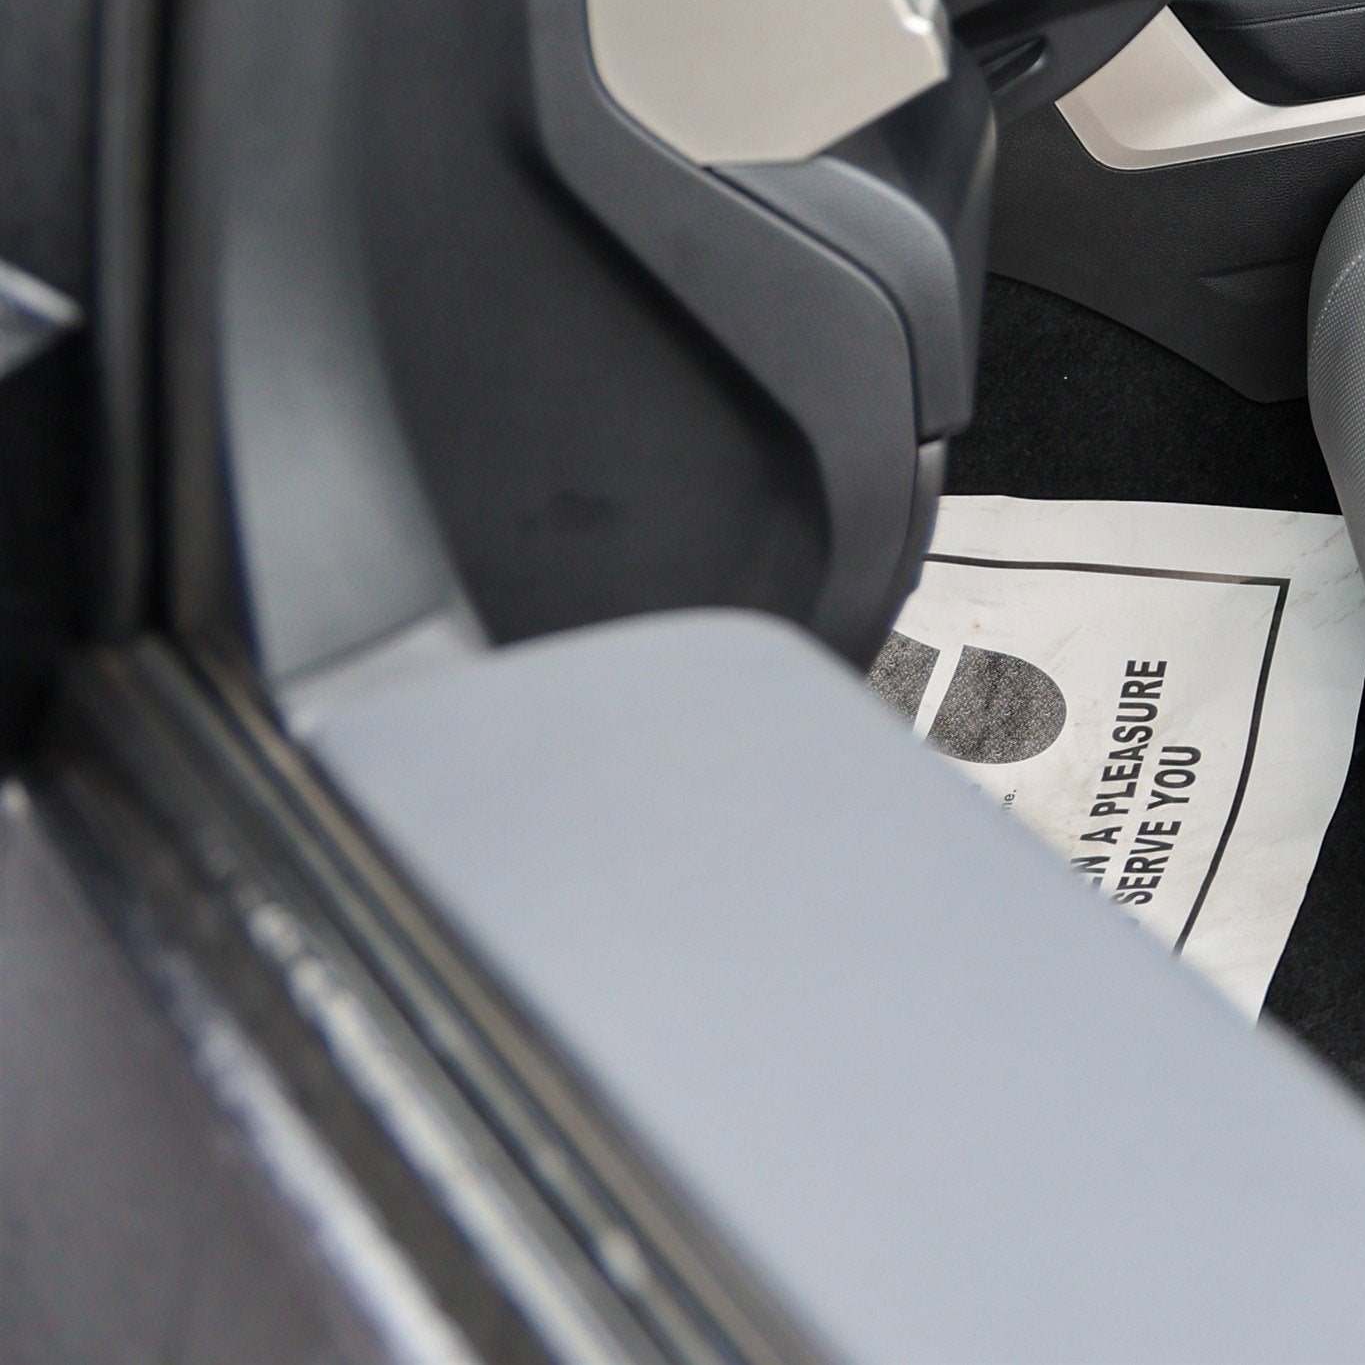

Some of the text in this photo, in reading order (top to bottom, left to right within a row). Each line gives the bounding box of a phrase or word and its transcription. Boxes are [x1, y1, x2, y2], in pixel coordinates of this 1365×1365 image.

[1089, 660, 1167, 818] PLEASURE
[1079, 825, 1123, 845] A
[1109, 745, 1202, 906] SERVE YOU
